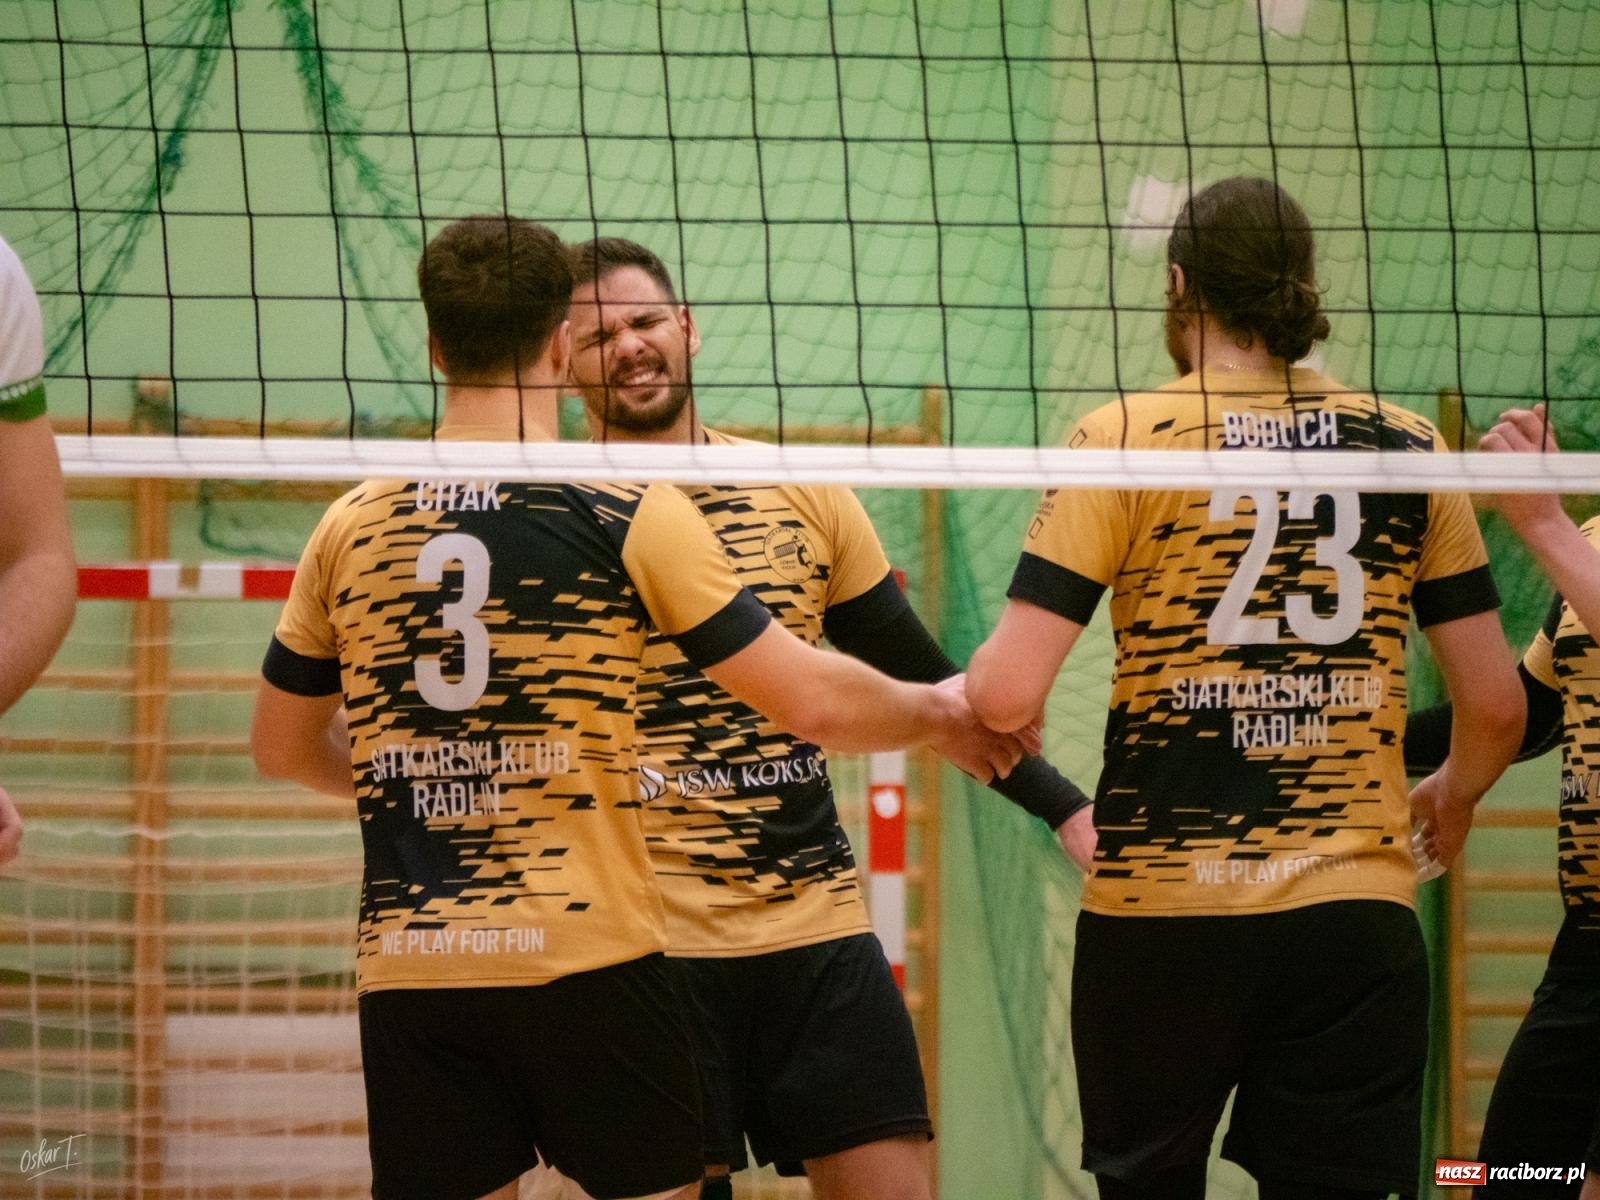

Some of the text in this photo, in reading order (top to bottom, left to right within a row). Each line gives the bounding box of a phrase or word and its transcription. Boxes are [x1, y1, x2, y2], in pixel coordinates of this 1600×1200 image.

[1207, 487, 1364, 645] 23
[414, 533, 491, 712] 3
[1171, 674, 1383, 711] SIATKARSKI KLUB
[1233, 714, 1329, 748] RADLIN
[500, 740, 570, 776] KLUB
[678, 767, 732, 798] JSW
[741, 758, 804, 788] KOKS
[413, 782, 500, 819] RADLIN
[1195, 861, 1225, 885] WE
[1230, 860, 1279, 885] PLAY
[381, 928, 545, 956] WE PLAY FOR FUN
